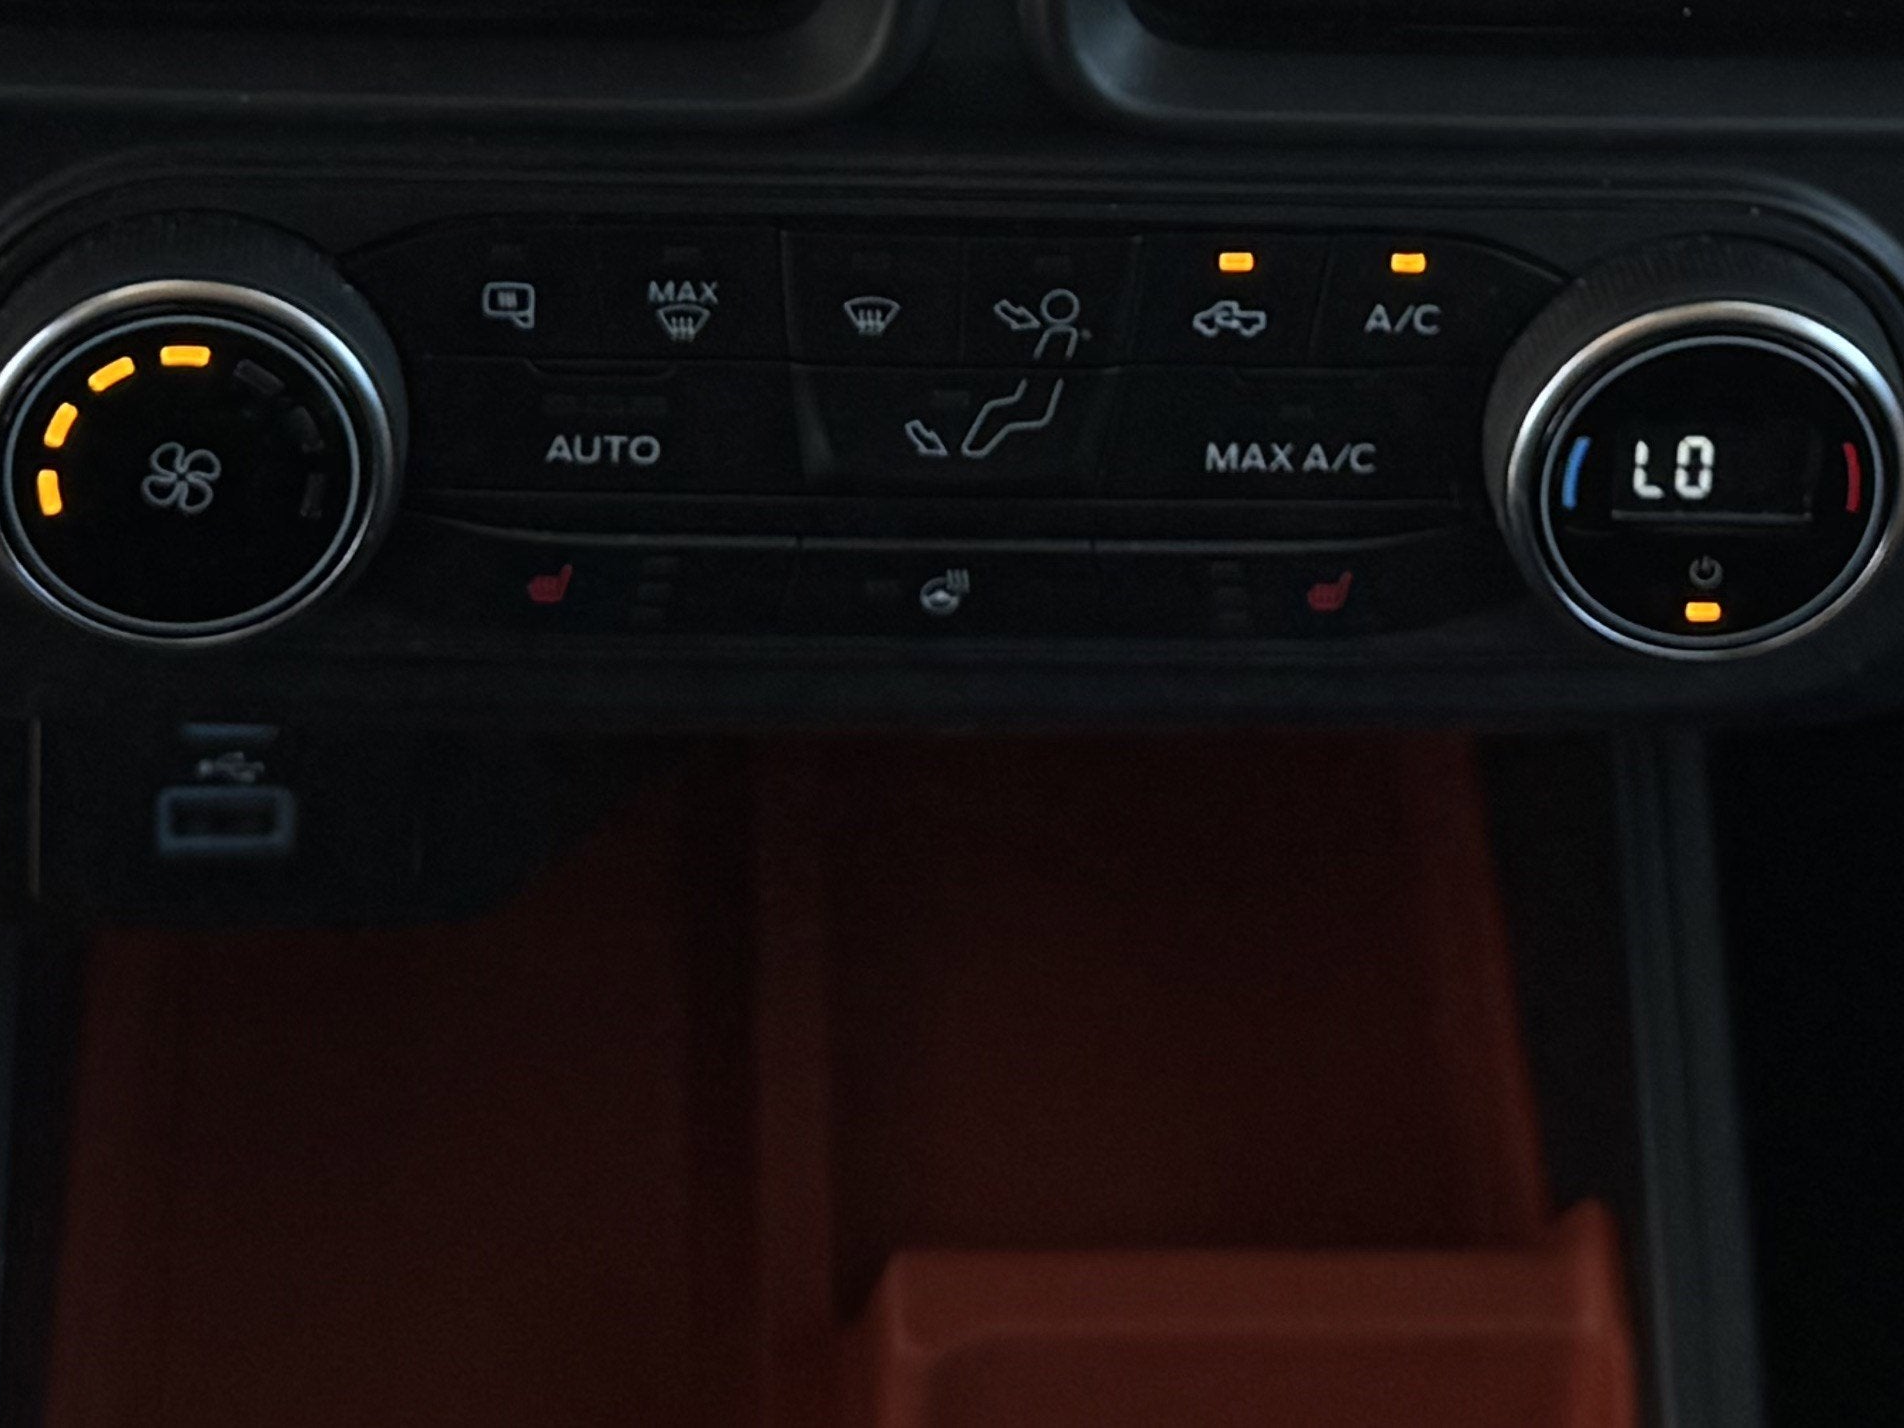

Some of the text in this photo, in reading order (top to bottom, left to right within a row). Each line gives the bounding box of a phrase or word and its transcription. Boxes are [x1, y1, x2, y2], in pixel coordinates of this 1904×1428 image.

[648, 279, 718, 305] MAX
[1364, 303, 1440, 335] A/C
[546, 434, 661, 465] AUTO
[1205, 442, 1375, 473] MAX A/C
